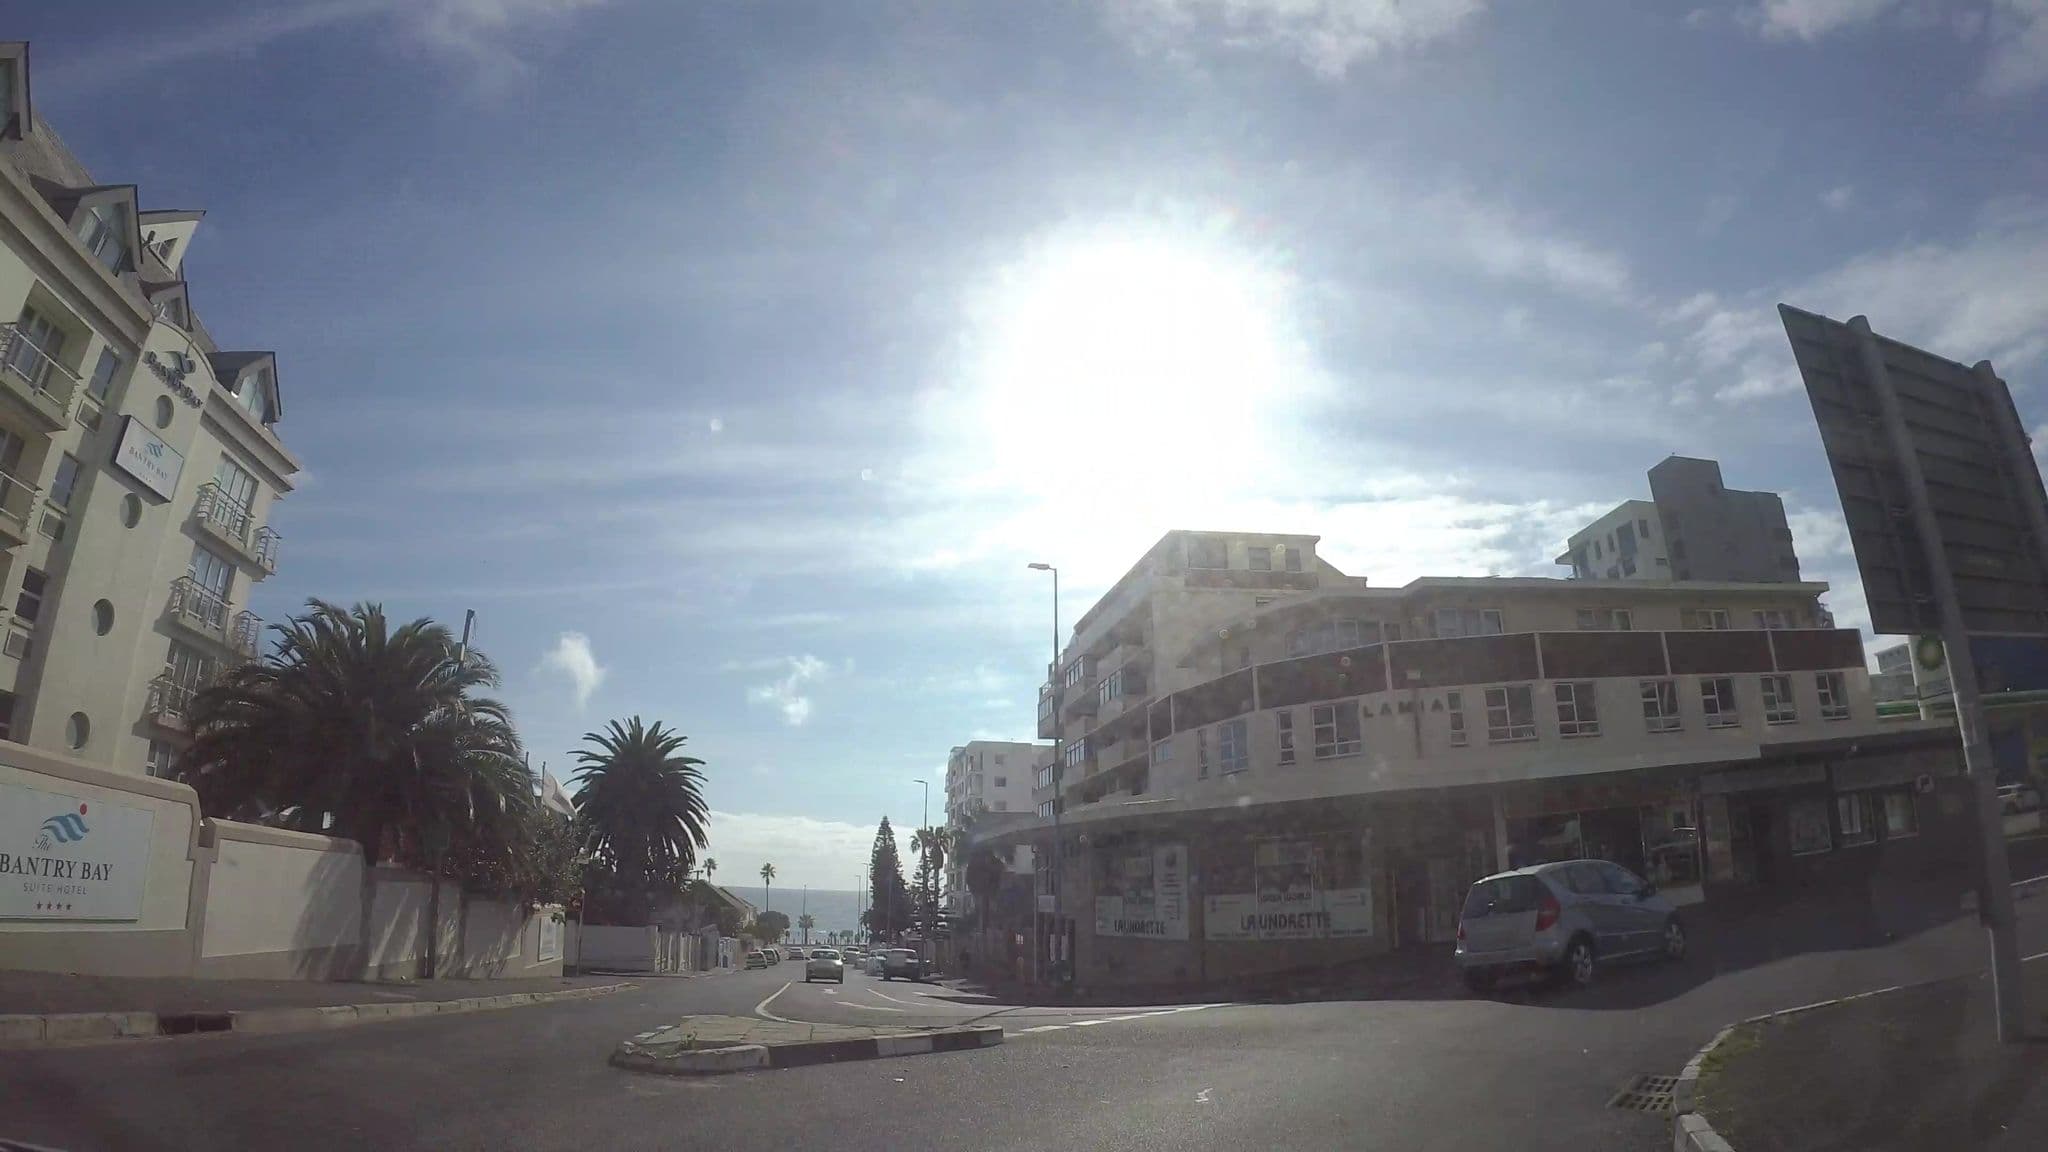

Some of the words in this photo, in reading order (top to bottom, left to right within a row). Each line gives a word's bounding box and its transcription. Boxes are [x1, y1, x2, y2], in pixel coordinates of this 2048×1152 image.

[0, 853, 77, 879] BANTRY
[81, 862, 113, 881] BAY
[23, 882, 52, 893] SUITE
[57, 884, 88, 896] HOTEL
[1240, 911, 1331, 930] LAUNDRETTE
